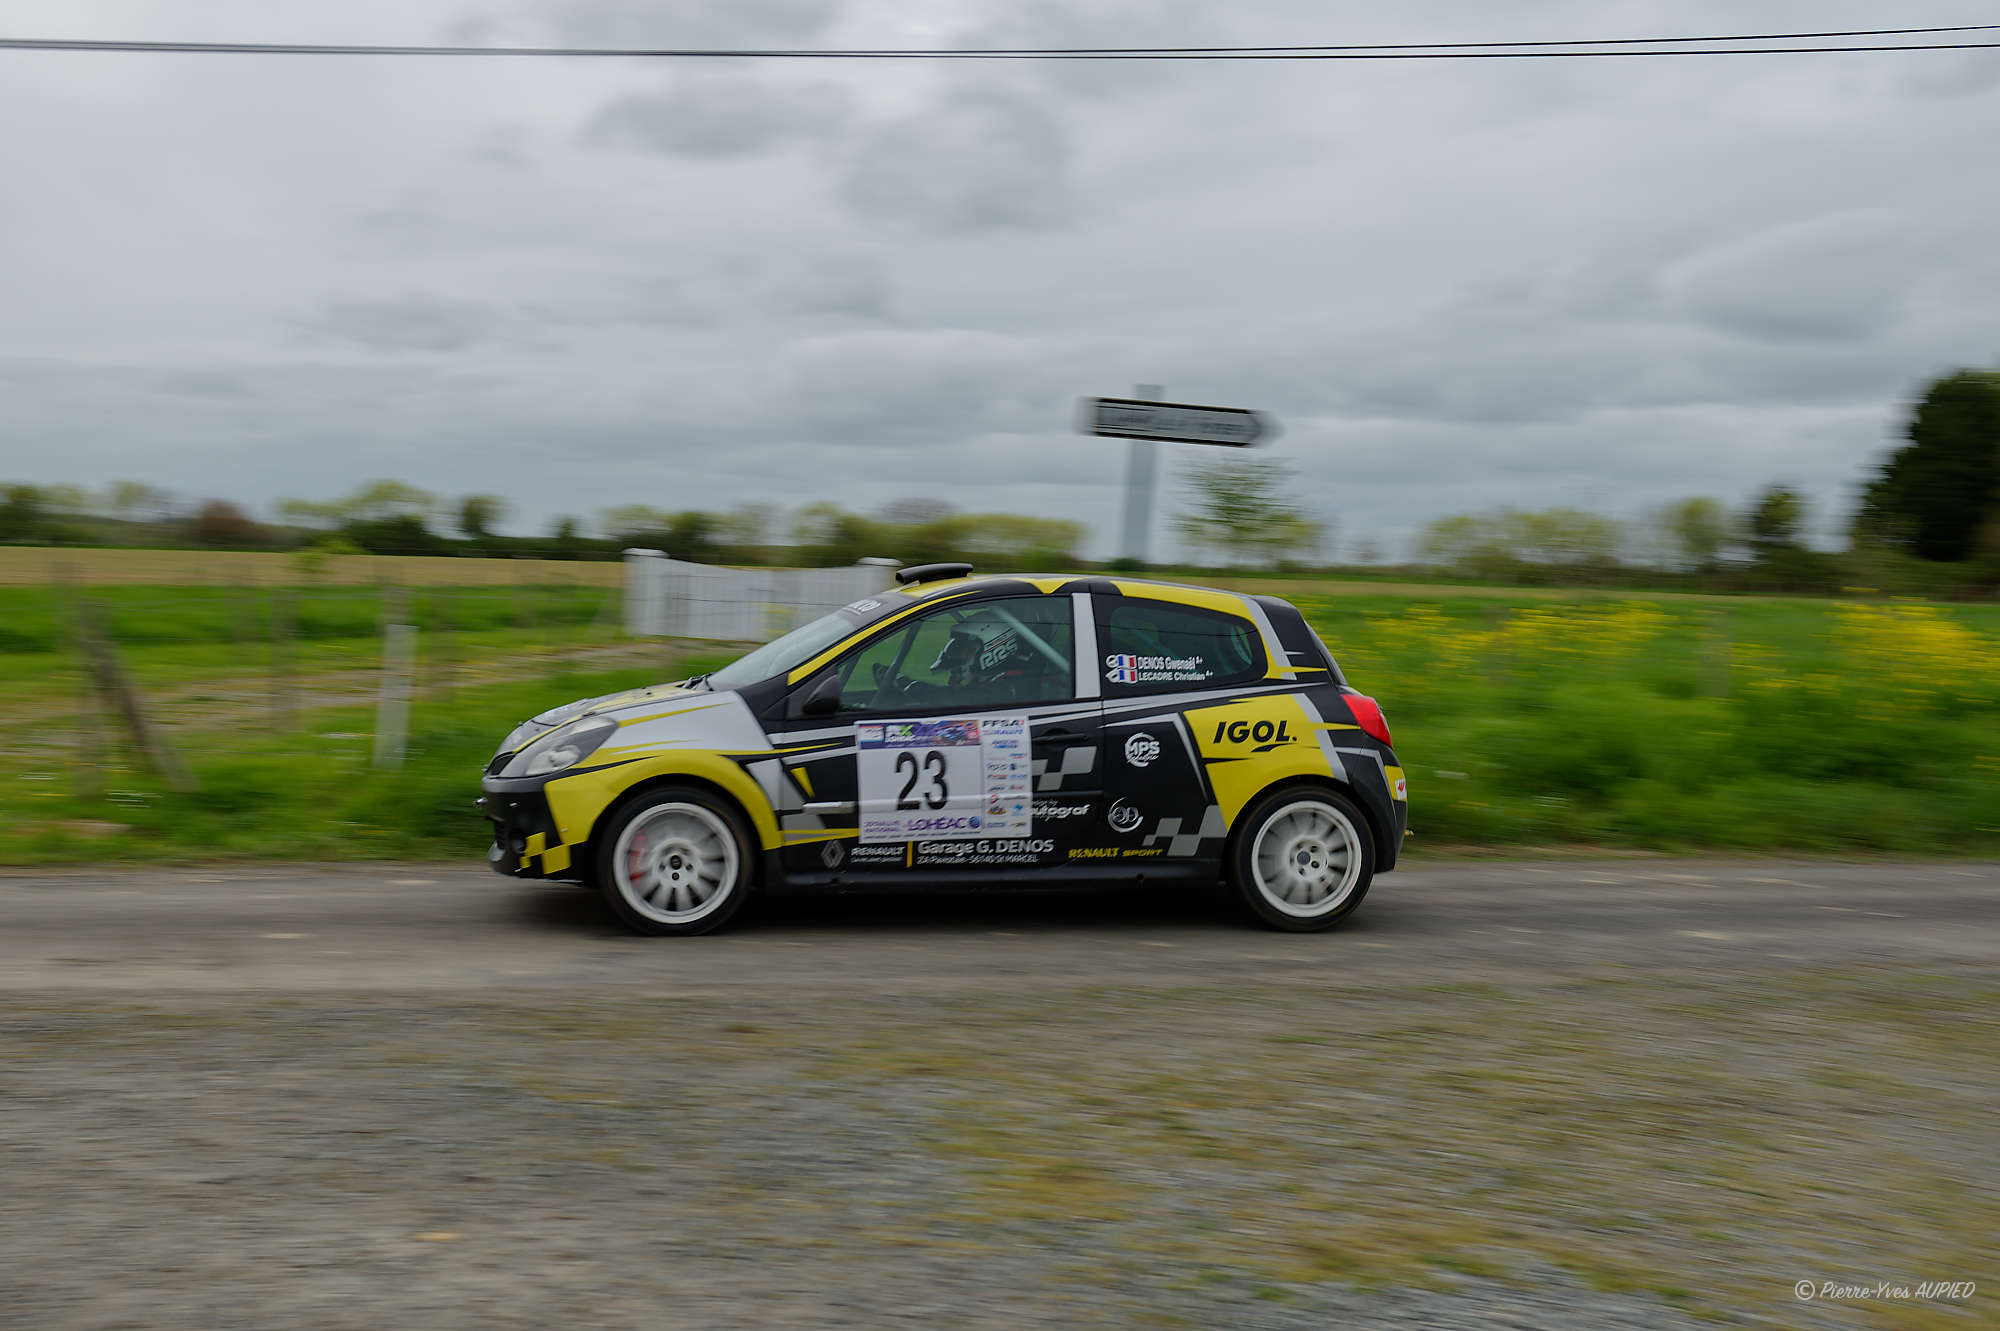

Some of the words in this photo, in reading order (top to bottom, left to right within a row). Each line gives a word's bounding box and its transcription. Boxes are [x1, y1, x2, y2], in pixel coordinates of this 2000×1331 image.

[1138, 656, 1165, 670] DENOS
[1138, 672, 1173, 681] LECADRE
[1174, 671, 1206, 681] Christian
[896, 750, 949, 811] 23
[851, 846, 906, 856] RENAULT
[918, 840, 975, 857] Garage
[996, 839, 1055, 853] DENOS
[1068, 848, 1120, 858] RENAULT
[1122, 849, 1163, 857] SPORT
